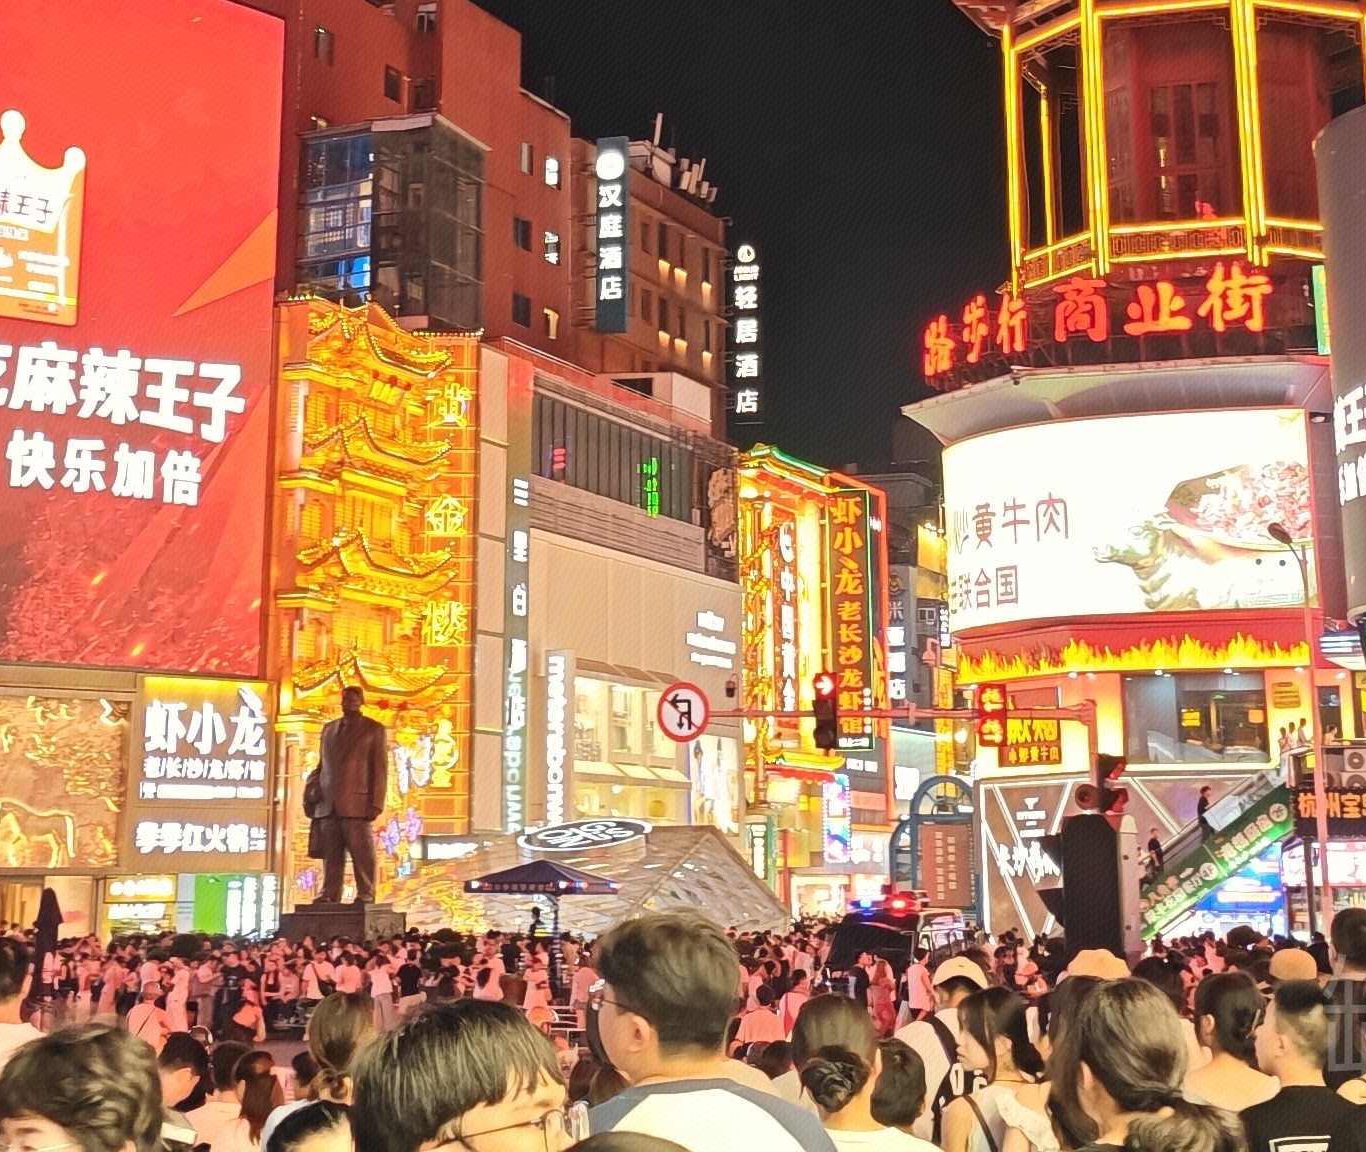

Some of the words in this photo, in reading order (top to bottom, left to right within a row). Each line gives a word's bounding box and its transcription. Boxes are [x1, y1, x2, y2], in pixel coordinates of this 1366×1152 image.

[599, 184, 624, 301] 汉庭酒店
[735, 285, 759, 414] 轻居酒店
[5, 429, 203, 508] 快乐加倍
[832, 496, 865, 596] 虾小龙
[144, 686, 267, 756] 虾小龙
[836, 601, 864, 735] 老长沙龙虾馆
